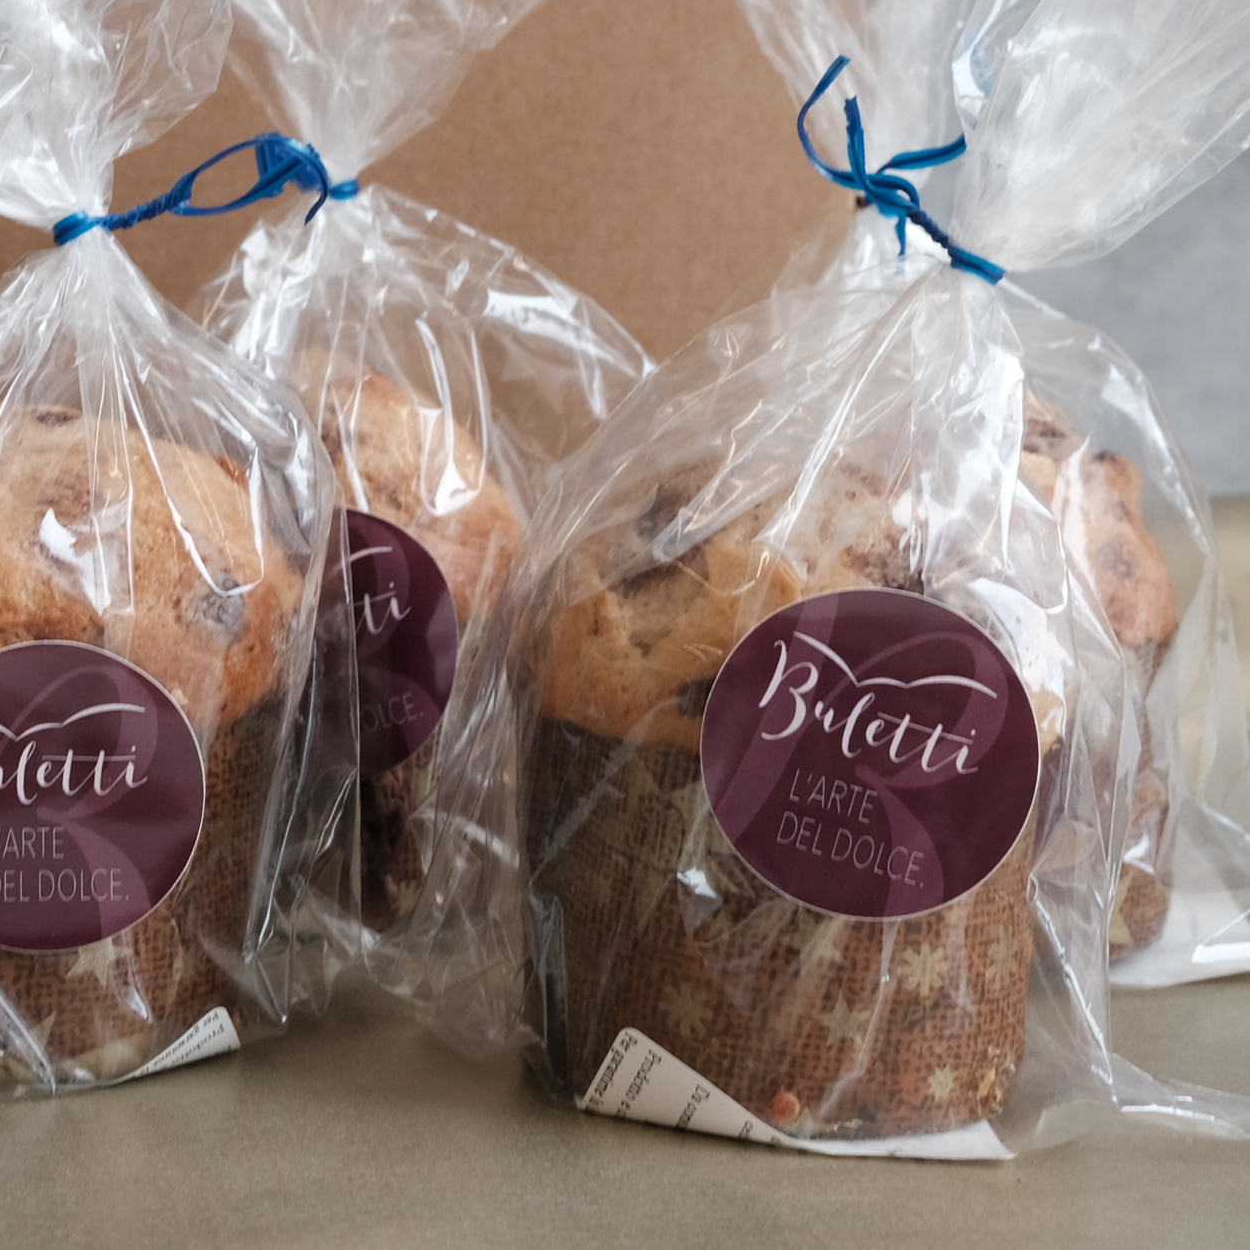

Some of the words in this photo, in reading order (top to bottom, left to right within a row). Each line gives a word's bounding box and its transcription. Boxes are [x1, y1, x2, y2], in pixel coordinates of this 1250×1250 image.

[359, 691, 424, 734] OLCE.
[758, 640, 979, 775] Buletti
[789, 768, 878, 825] L'ARTE
[777, 810, 823, 858] DEL
[831, 827, 924, 889] DOLCE.
[38, 867, 129, 902] DOLCE.
[625, 1049, 662, 1102] Prodotto
